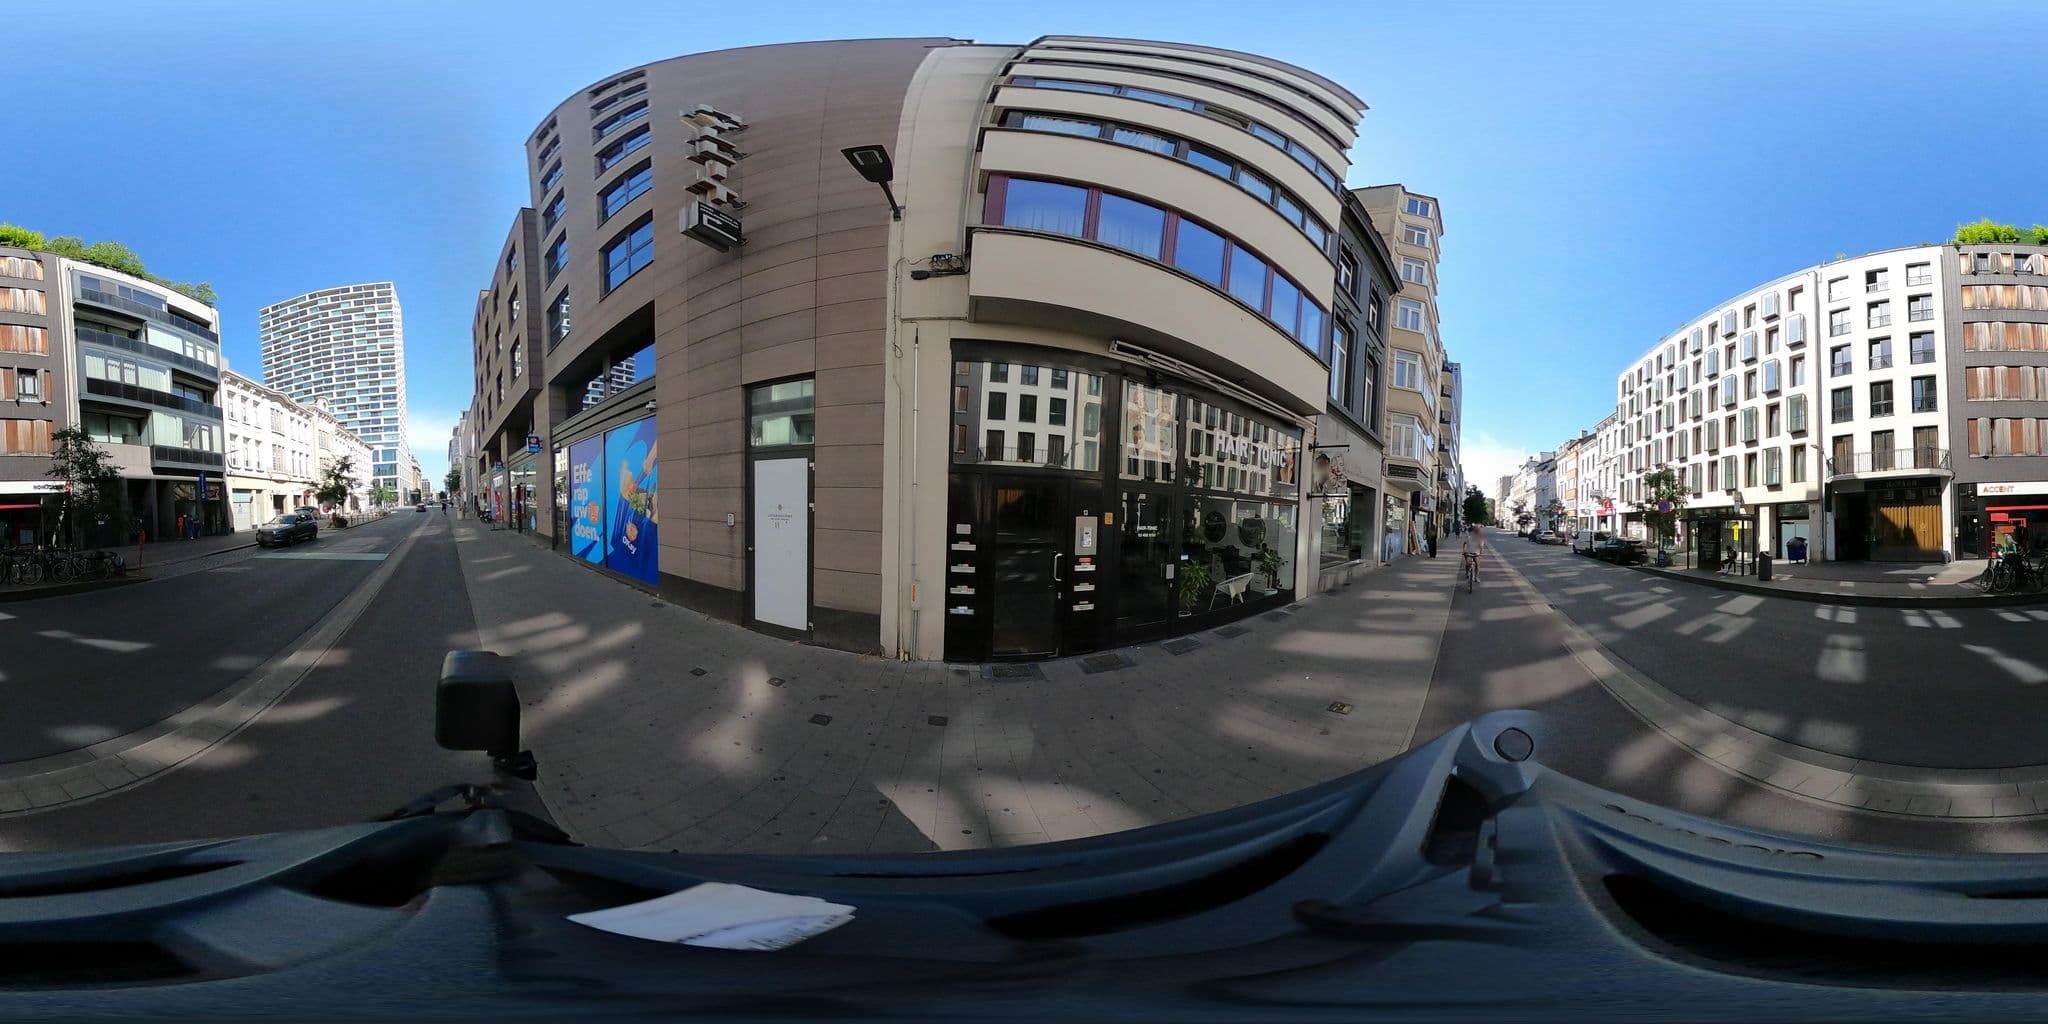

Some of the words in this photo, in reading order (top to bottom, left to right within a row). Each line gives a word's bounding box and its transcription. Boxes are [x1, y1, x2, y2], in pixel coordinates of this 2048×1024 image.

[1216, 432, 1248, 458] HAIR
[1258, 447, 1287, 468] TONIC
[574, 463, 592, 484] Effe
[574, 488, 588, 505] rap
[1983, 485, 2015, 493] ACCENT
[575, 505, 588, 518] uw
[574, 519, 600, 541] doen.
